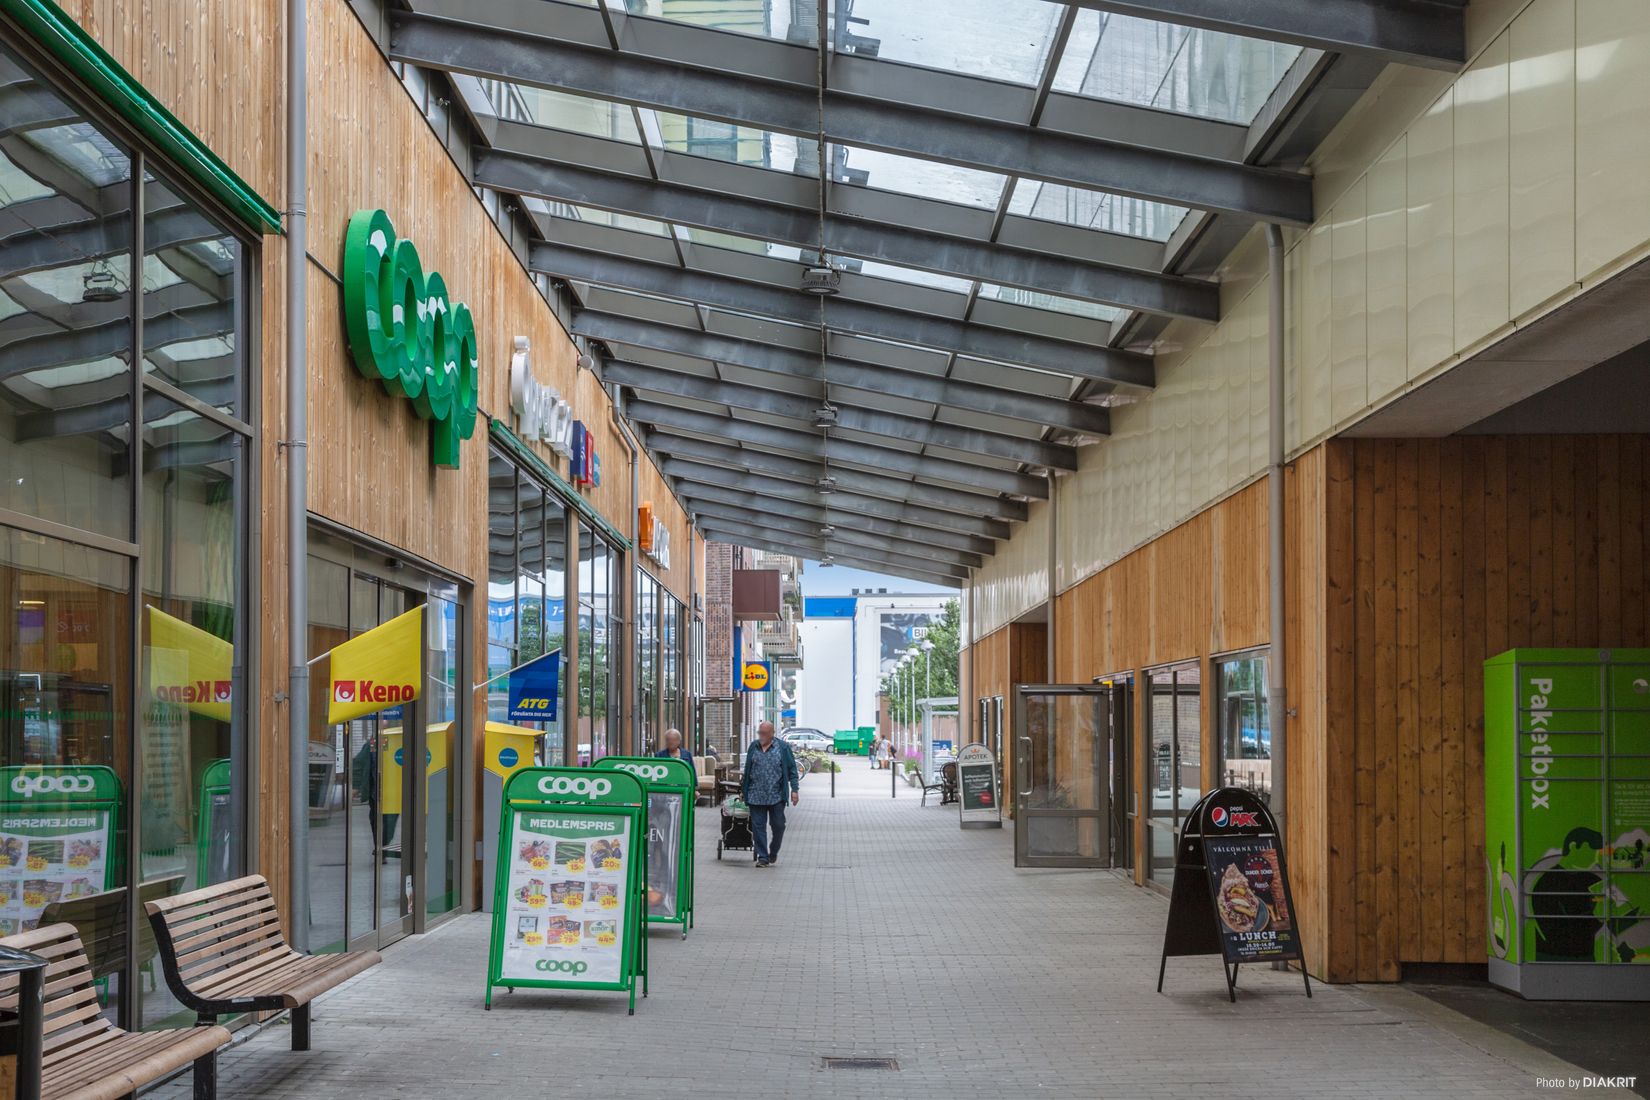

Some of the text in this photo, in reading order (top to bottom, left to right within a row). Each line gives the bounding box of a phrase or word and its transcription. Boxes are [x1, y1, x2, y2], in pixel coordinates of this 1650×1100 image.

[360, 680, 414, 702] Keno
[517, 698, 550, 709] ATG
[1531, 678, 1553, 809] Paketbox
[538, 776, 611, 799] coop
[530, 818, 615, 831] MEDLEMSPRIS
[1230, 812, 1258, 827] MAX
[1240, 931, 1277, 940] LUNCH
[536, 960, 588, 976] coop
